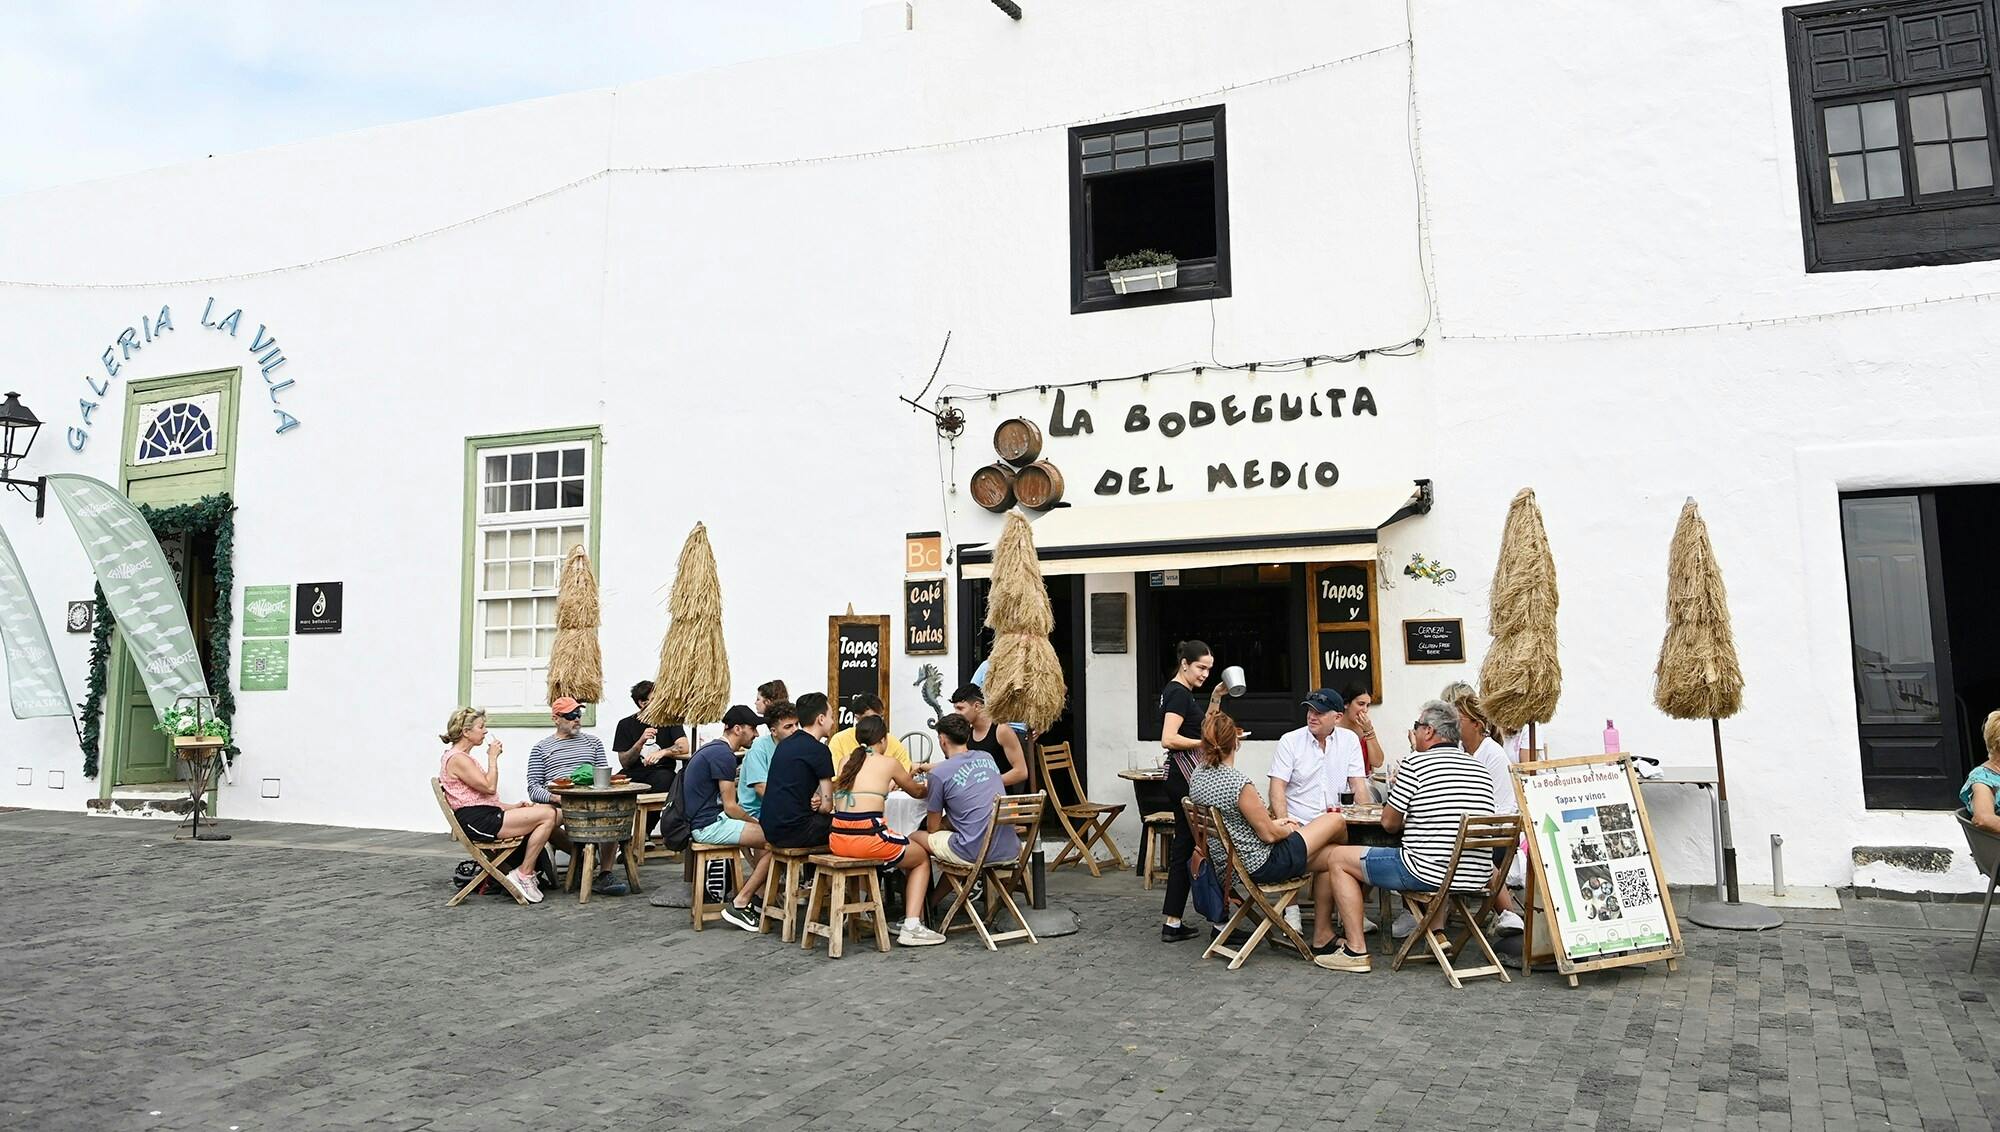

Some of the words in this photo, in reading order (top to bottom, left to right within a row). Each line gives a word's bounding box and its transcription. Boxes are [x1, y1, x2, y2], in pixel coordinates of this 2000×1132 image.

[67, 304, 174, 453] GALERIA
[200, 296, 243, 337] LA
[249, 323, 301, 435] VILLA
[1048, 388, 1094, 437] LA
[1094, 465, 1174, 496] DEL
[1207, 458, 1339, 492] MEDIO
[908, 542, 938, 568] Bc
[910, 582, 941, 604] Café
[1321, 579, 1364, 603] Tapas
[922, 608, 931, 621] y
[1349, 607, 1360, 621] y
[910, 625, 943, 644] Tartas
[1418, 625, 1445, 635] CERVEZA
[840, 636, 879, 659] Tapas
[841, 660, 868, 670] para
[870, 658, 877, 668] 2
[1324, 650, 1368, 671] Vinos
[1532, 780, 1543, 789] La
[1543, 777, 1582, 788] Bodeguita
[1583, 774, 1594, 783] Del
[1595, 772, 1619, 782] Medio
[1555, 795, 1577, 805] Tapas
[1578, 795, 1583, 804] y
[1584, 792, 1607, 801] vinos
